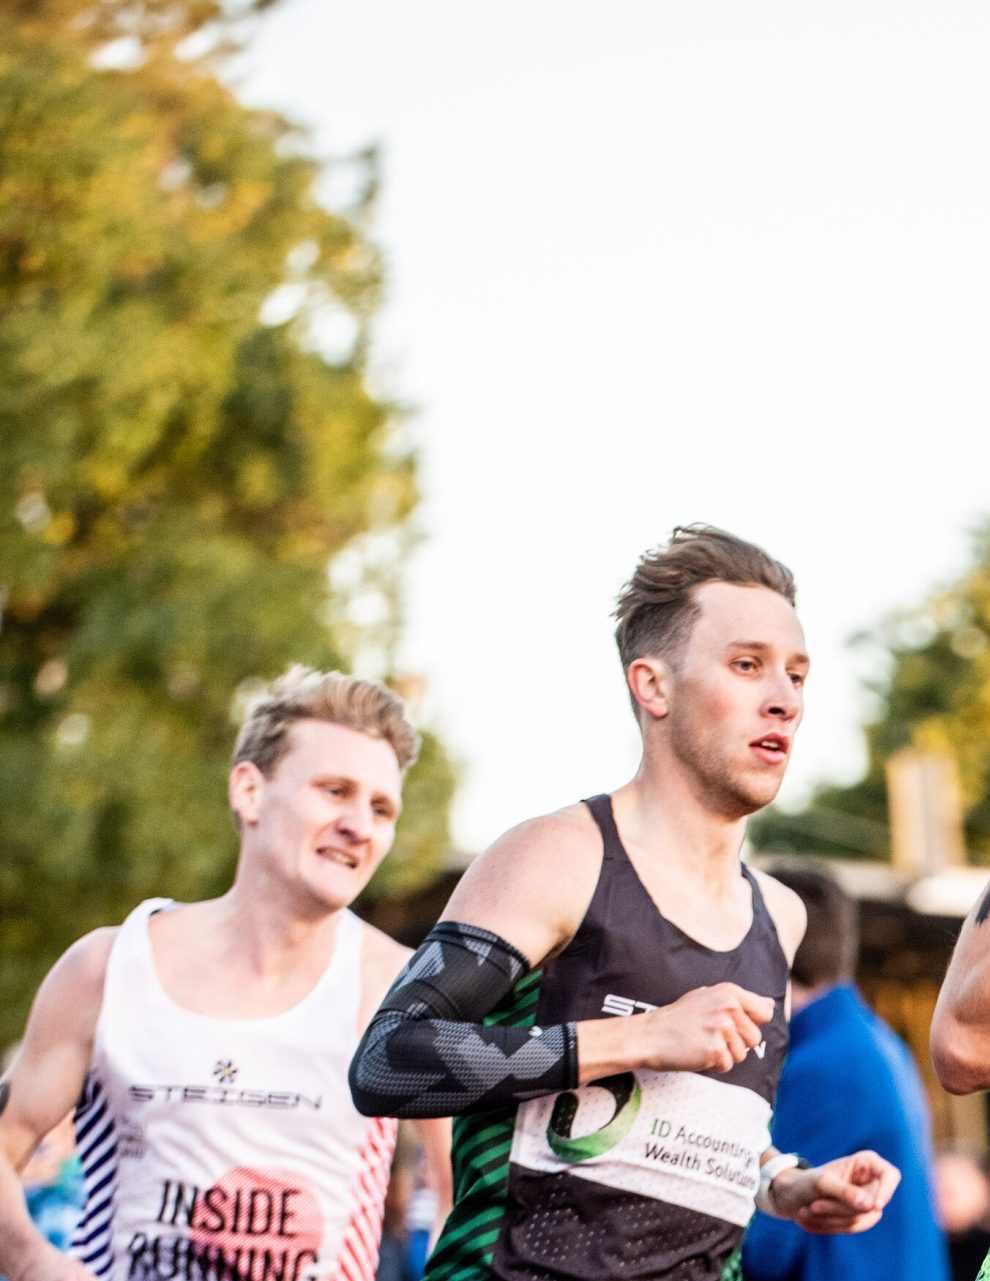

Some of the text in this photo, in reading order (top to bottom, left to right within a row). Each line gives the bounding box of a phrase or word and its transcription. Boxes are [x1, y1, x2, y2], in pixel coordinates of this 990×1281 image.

[128, 1083, 323, 1111] STEIGEN
[650, 1117, 673, 1138] ID
[644, 1141, 701, 1171] Wealth
[156, 1178, 302, 1239] INSIDE
